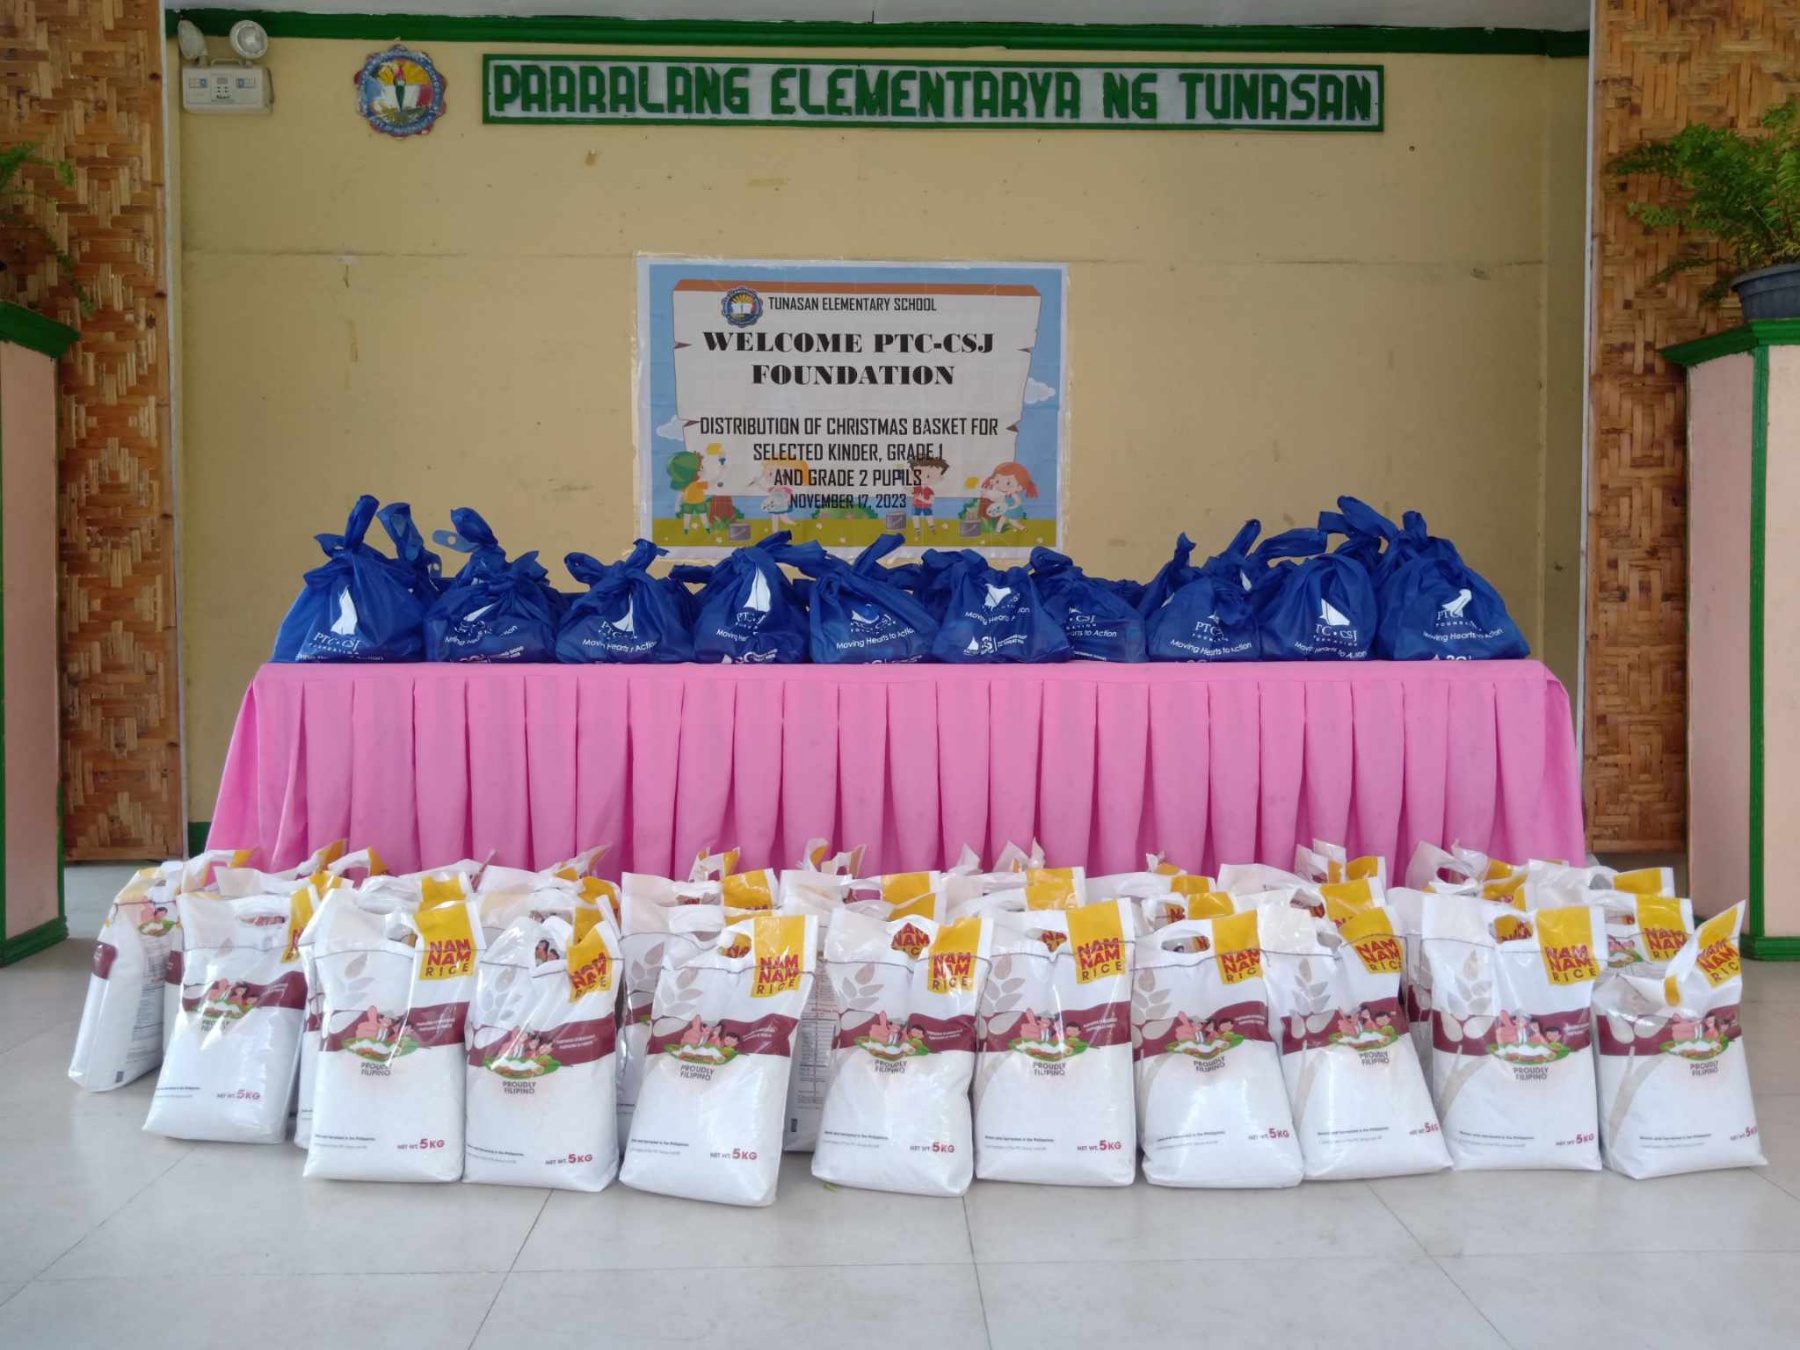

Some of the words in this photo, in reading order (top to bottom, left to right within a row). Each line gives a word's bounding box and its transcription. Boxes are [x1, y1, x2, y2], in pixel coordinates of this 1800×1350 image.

[494, 65, 750, 114] PAARALANG
[770, 68, 1081, 119] ELEMENTARYA
[1102, 72, 1158, 119] NG
[1178, 73, 1372, 121] TUNASAN
[768, 297, 819, 311] TUNASAN
[822, 298, 890, 311] ELEMENTARY
[894, 298, 937, 311] SCHOOL
[702, 331, 863, 353] WELCOME
[873, 333, 994, 353] PTC-CSJ
[752, 364, 956, 385] FOUNDATION
[700, 417, 799, 435] DISTRIBUTION
[804, 418, 822, 435] OF
[826, 418, 908, 435] CHRISTMAS
[912, 418, 967, 435] BASKET
[971, 418, 998, 435] FOR
[753, 443, 823, 461] SELECTED
[828, 443, 882, 463] KINDER,
[887, 443, 934, 461] GRADE
[774, 469, 803, 486] AND
[808, 469, 855, 486] GRADE
[859, 469, 868, 486] 2
[873, 469, 922, 486] PUPILS
[790, 493, 853, 508] NOVEMBER
[876, 493, 907, 508] 2023
[837, 640, 865, 650] Moving
[867, 635, 889, 645] Hearts
[430, 939, 470, 952] NAM
[1077, 938, 1119, 954] NAM
[1355, 939, 1397, 953] NAM
[1545, 945, 1588, 959] NAM
[428, 950, 471, 965] NAM
[760, 955, 799, 969] NAM
[1080, 950, 1120, 970] NAM
[1221, 949, 1260, 964] NAM
[1361, 948, 1400, 963] NAM
[1700, 947, 1738, 973] NAM
[426, 963, 469, 976] RICE
[1082, 961, 1122, 980] RICE
[1224, 958, 1260, 974] NAM
[1549, 957, 1592, 972] NAM
[1711, 960, 1739, 982] RIC
[758, 967, 800, 983] NAM
[1226, 967, 1257, 982] RIC
[1552, 967, 1596, 981] RICE
[757, 979, 795, 994] RICE
[933, 976, 968, 990] RICE
[680, 1071, 711, 1081] FILIPINO
[681, 1064, 715, 1076] PROUDLY
[420, 1138, 445, 1149] 5KG
[932, 1142, 955, 1153] 5KG
[1099, 1139, 1122, 1151] 5KG
[568, 1154, 593, 1164] 5KG
[732, 1148, 758, 1160] 5KG
